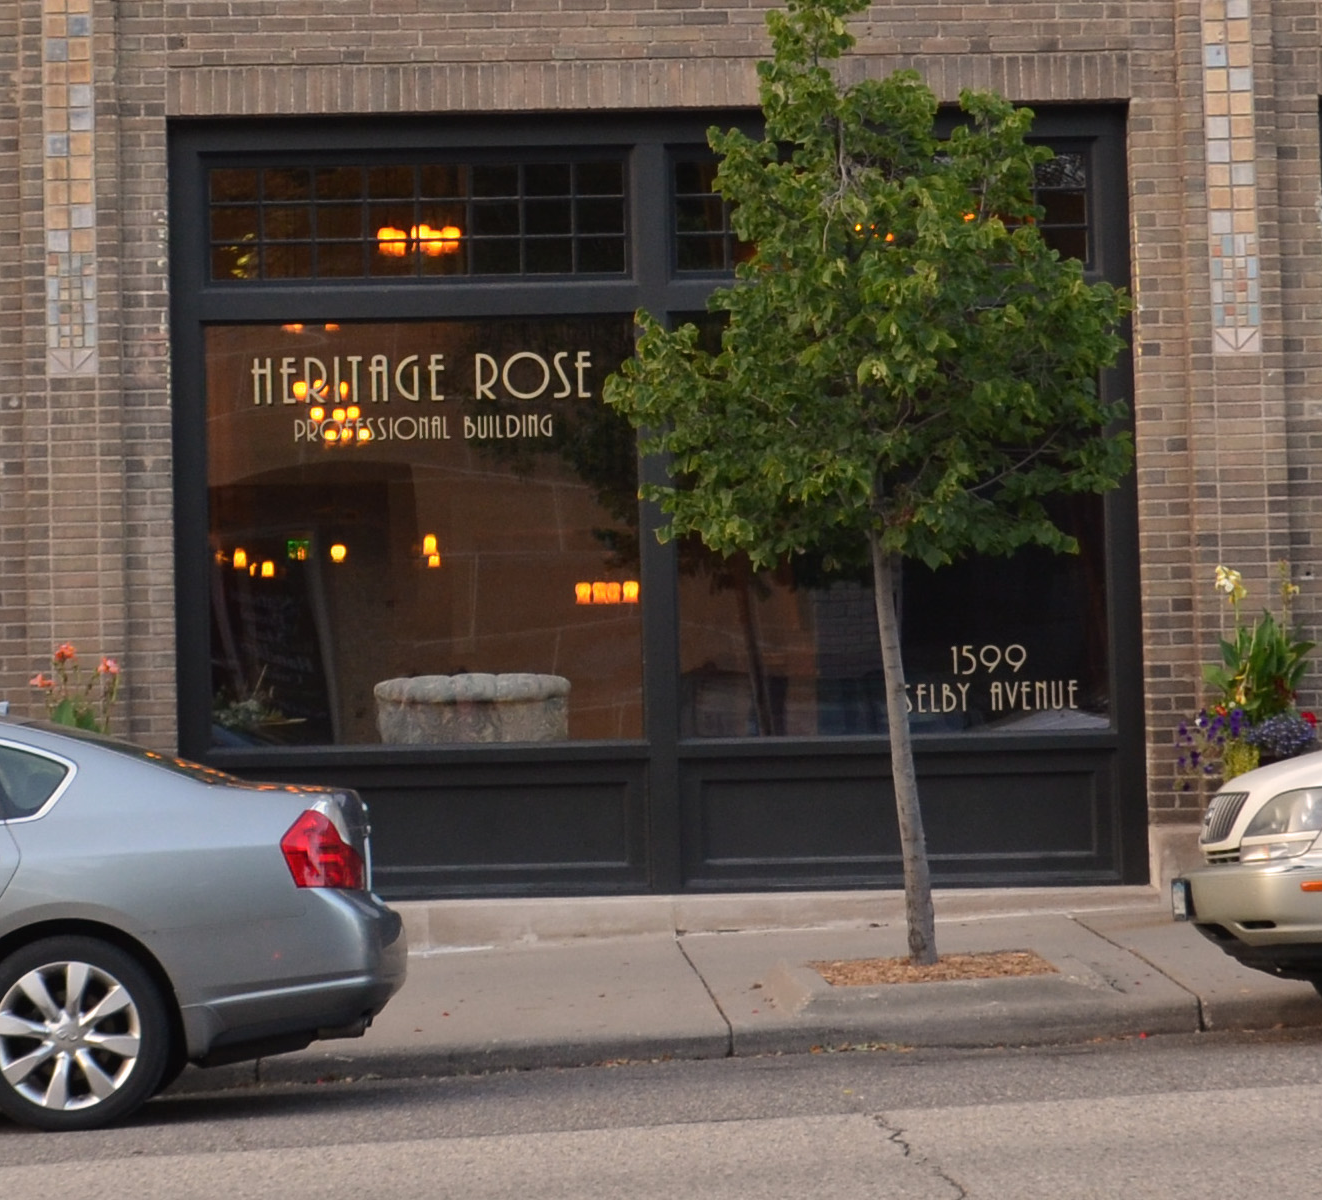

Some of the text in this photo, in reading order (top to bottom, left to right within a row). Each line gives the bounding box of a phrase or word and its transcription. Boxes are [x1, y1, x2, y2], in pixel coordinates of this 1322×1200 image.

[251, 350, 593, 405] HERITAGE ROSE
[293, 413, 554, 443] PROFESSIONAL BUILDING
[950, 644, 1027, 676] 1599
[989, 679, 1080, 712] AVENUE
